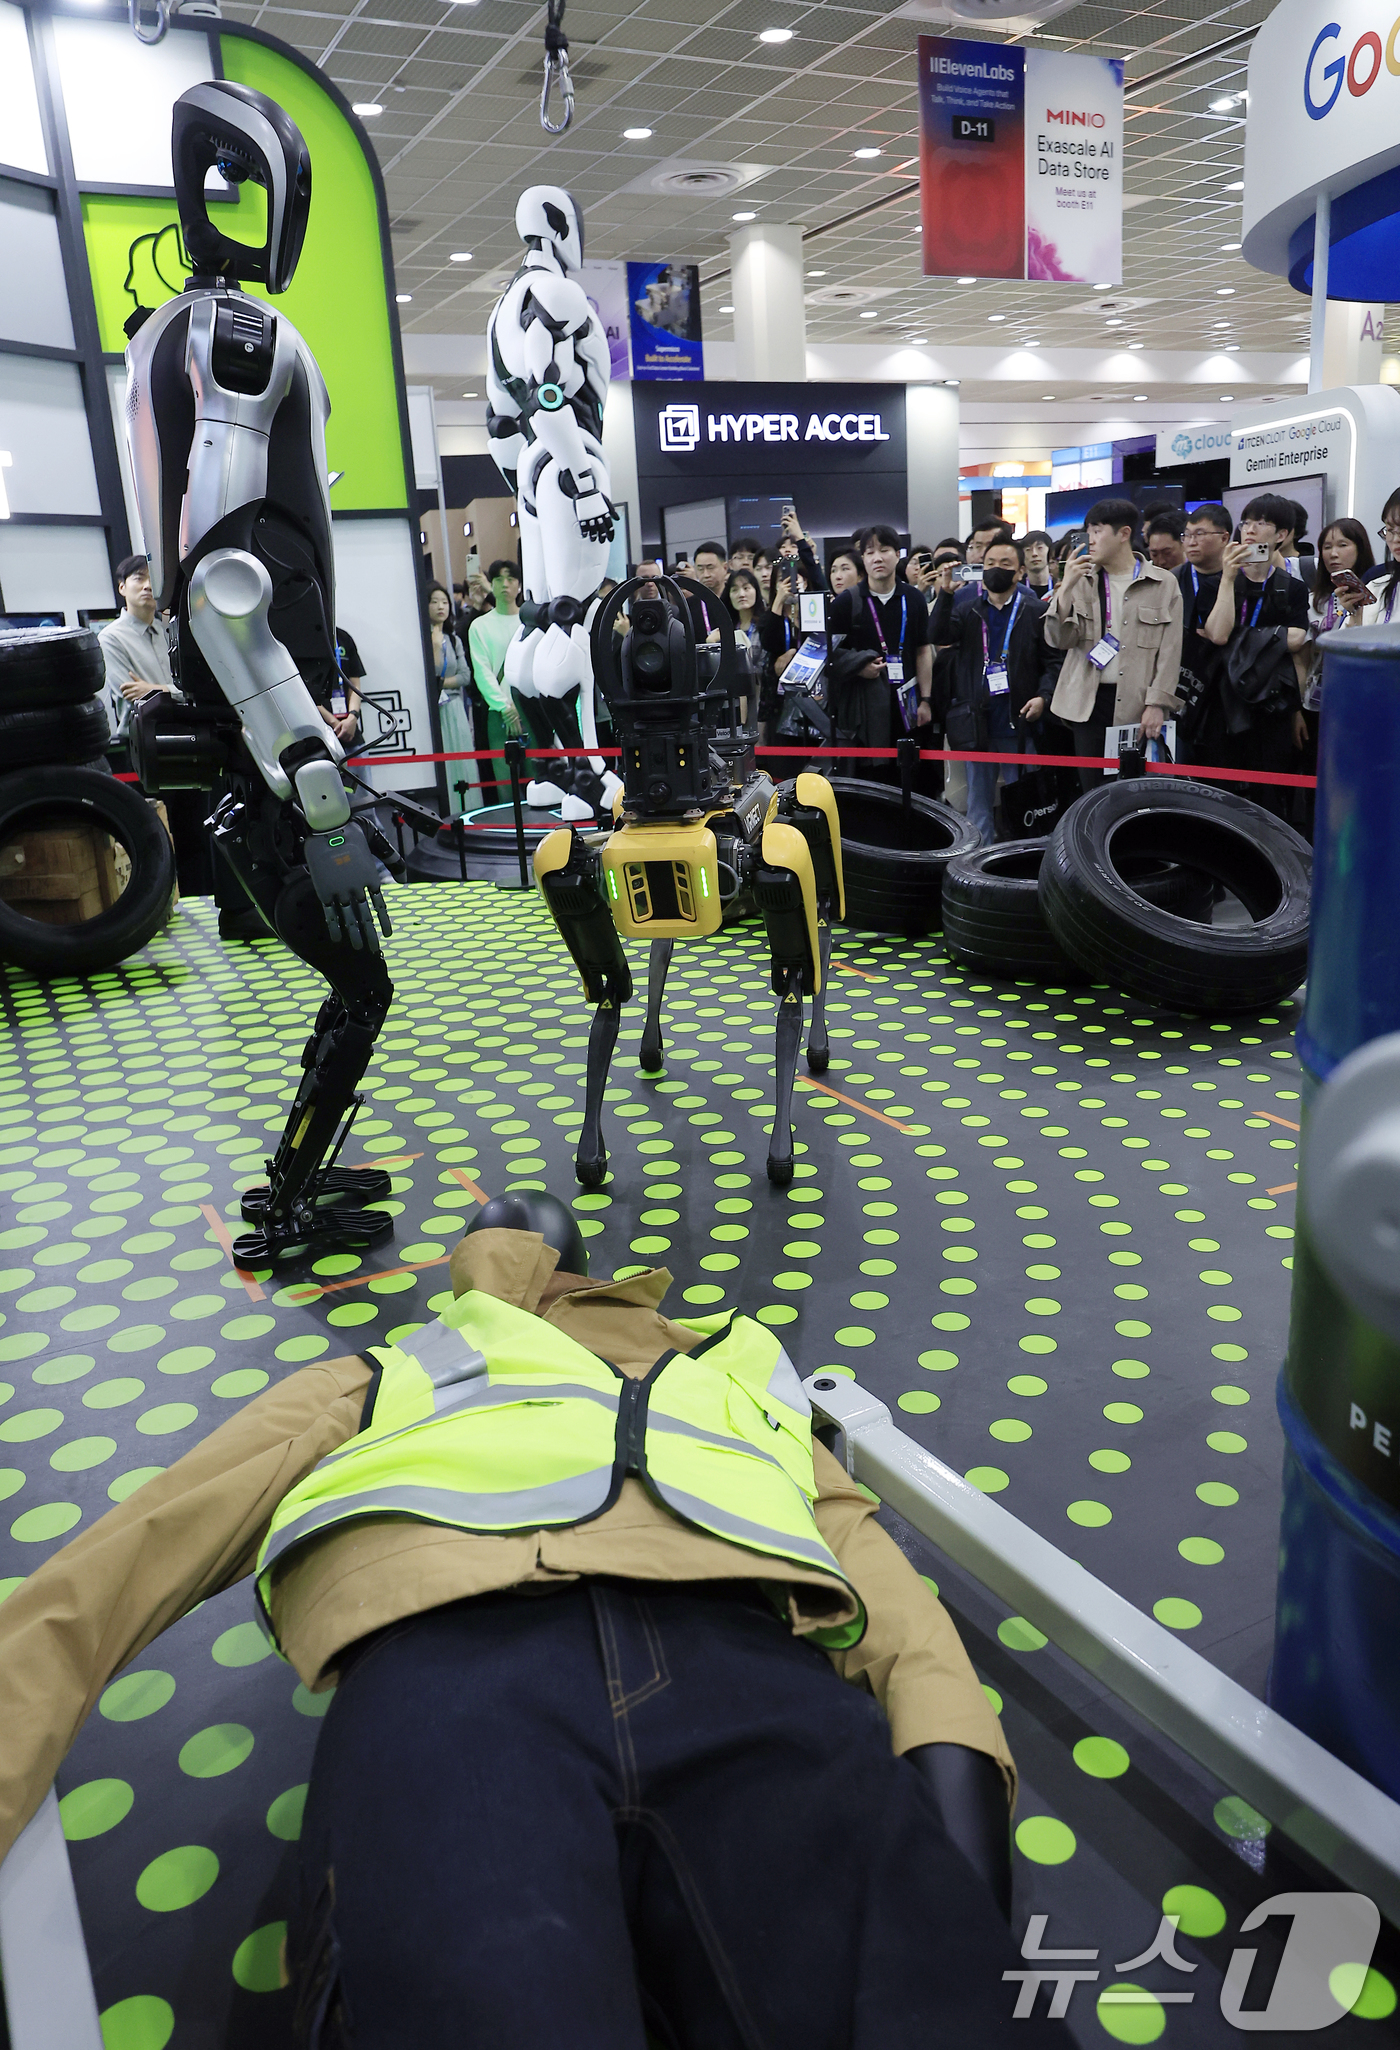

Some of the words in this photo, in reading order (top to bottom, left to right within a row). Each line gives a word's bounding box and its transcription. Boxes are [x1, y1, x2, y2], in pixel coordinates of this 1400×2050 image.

[936, 83, 953, 92] Build
[954, 85, 972, 94] Voice
[973, 87, 995, 97] Agents
[996, 90, 1009, 98] that
[966, 99, 979, 107] and
[979, 99, 994, 108] Take
[994, 102, 1016, 110] Action
[961, 120, 988, 137] D-11
[1037, 134, 1097, 157] Exascale
[1100, 141, 1114, 158] AI
[1038, 158, 1070, 177] Data
[1074, 161, 1110, 180] Store
[1055, 186, 1076, 197] Meet
[1076, 190, 1087, 198] us
[1088, 190, 1097, 199] at
[1056, 199, 1079, 209] booth
[1081, 200, 1093, 210] E11
[707, 413, 800, 443] HYPER
[803, 412, 891, 443] ACCEL
[1288, 423, 1316, 440] Google
[1318, 417, 1342, 434] Cloud
[1245, 453, 1277, 472] Gemini
[1278, 445, 1329, 466] Enterprise
[1349, 1402, 1394, 1459] PE
